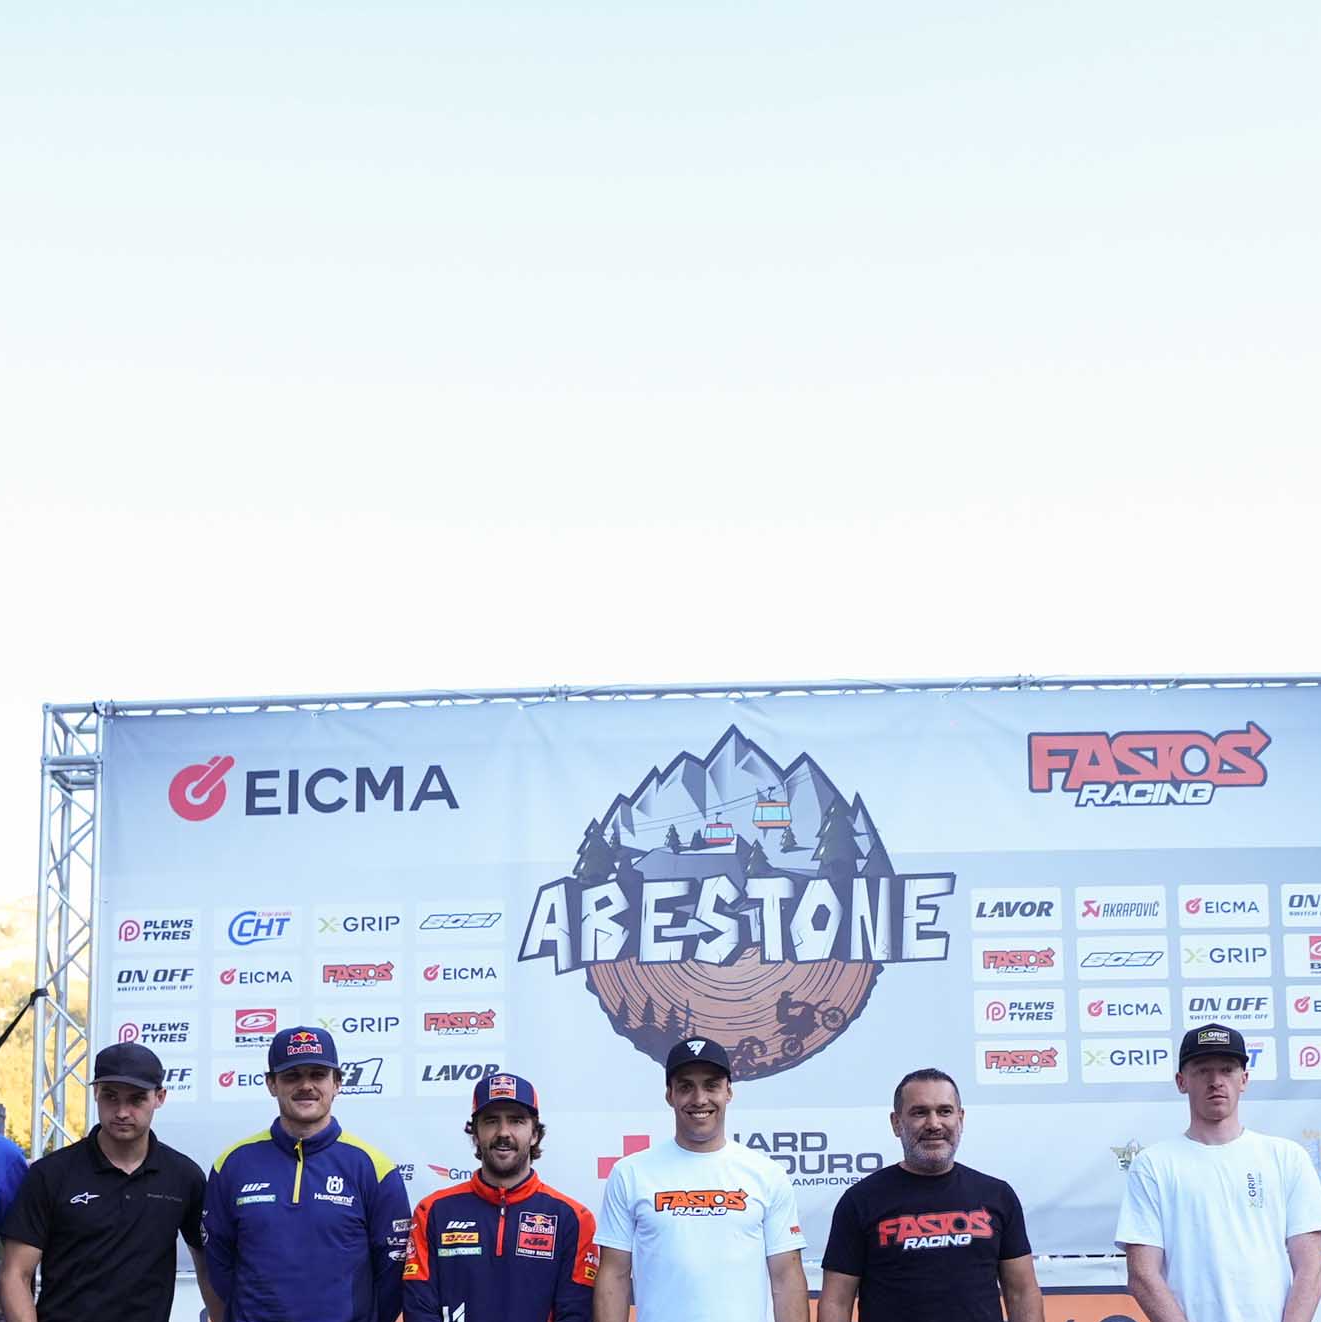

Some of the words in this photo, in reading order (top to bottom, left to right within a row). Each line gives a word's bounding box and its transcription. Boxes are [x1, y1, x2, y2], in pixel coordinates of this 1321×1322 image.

[244, 764, 460, 816] EICMA
[1075, 782, 1215, 807] RACING
[1204, 901, 1260, 914] EICMA
[1288, 894, 1320, 908] ON
[976, 901, 1054, 917] LAVOR
[143, 919, 194, 929] PLEWS
[142, 930, 191, 942] TYRES
[117, 969, 148, 984] ON
[153, 968, 194, 983] OFF
[239, 970, 293, 984] EICMA
[442, 966, 497, 980] EICMA
[1008, 1001, 1055, 1010] PLEWS
[1107, 1003, 1163, 1016] EICMA
[1189, 998, 1222, 1012] ON
[1226, 997, 1269, 1011] OFF
[1008, 1011, 1054, 1021] TYRES
[141, 1022, 189, 1032] PLEWS
[141, 1032, 189, 1042] TYRES
[422, 1063, 500, 1081] LAVOR
[314, 1192, 356, 1204] Husqvarna
[674, 1206, 727, 1216] RACING
[443, 1234, 476, 1243] DHL
[903, 1233, 972, 1250] RACING
